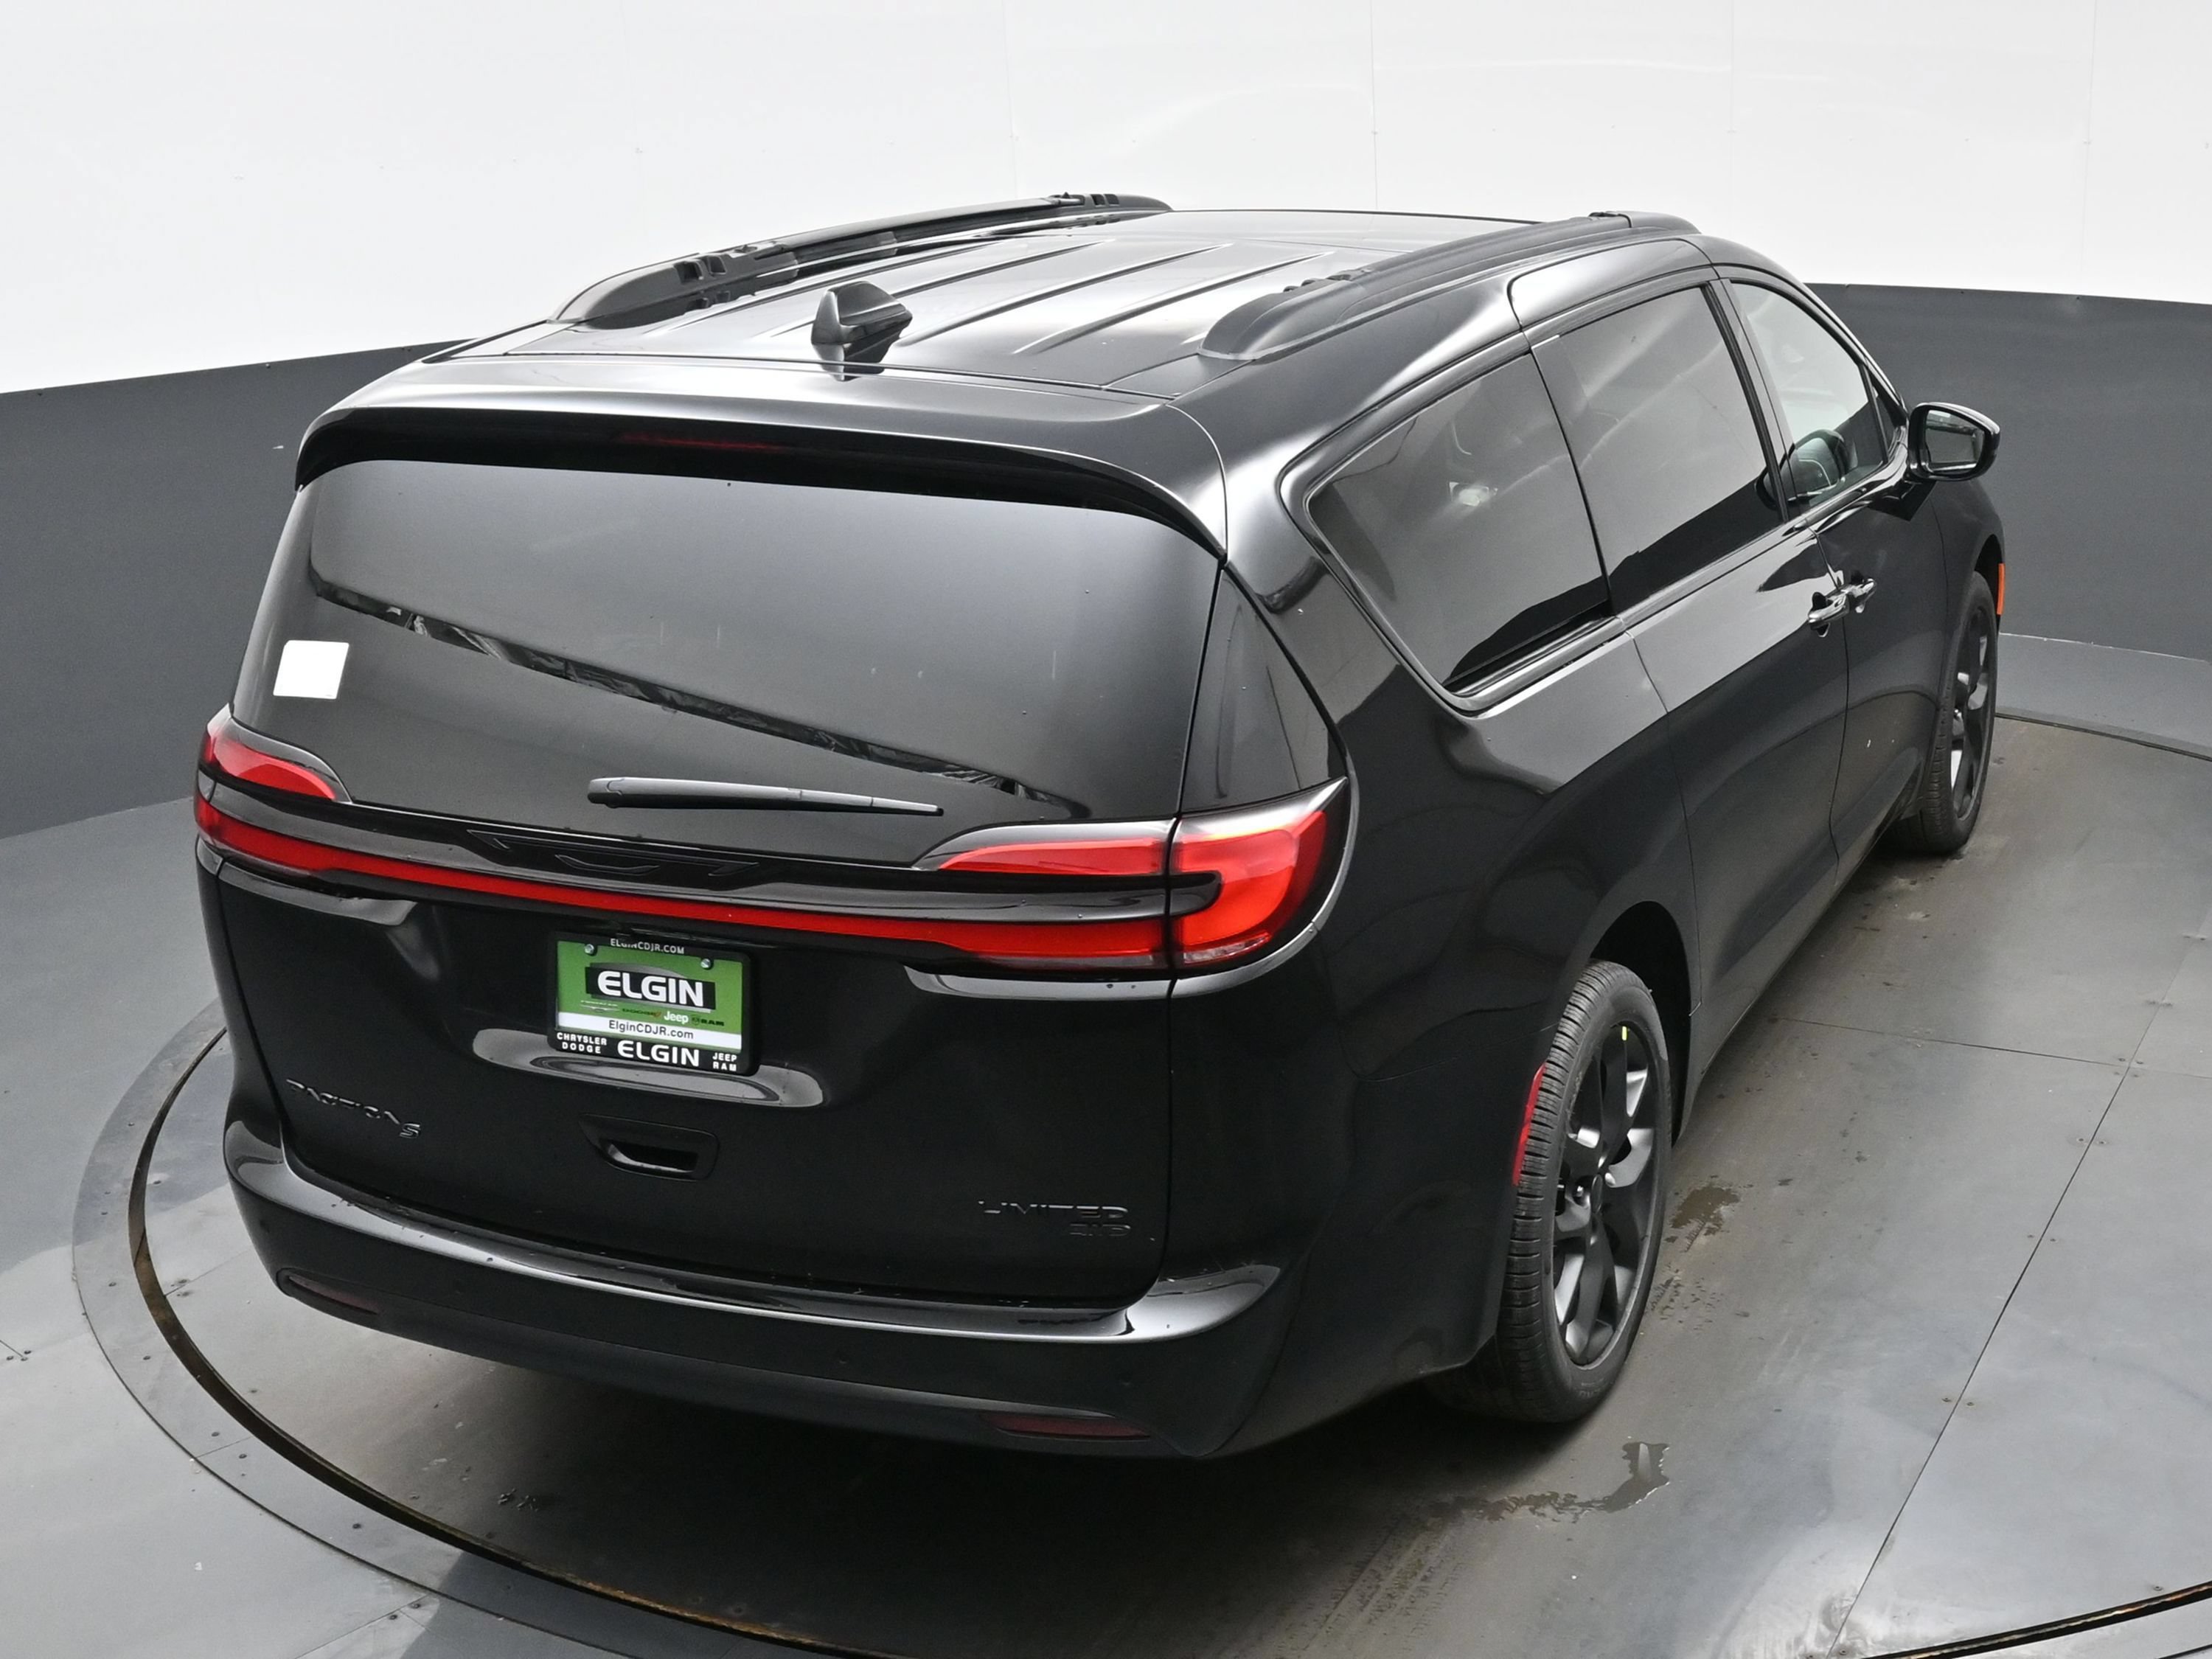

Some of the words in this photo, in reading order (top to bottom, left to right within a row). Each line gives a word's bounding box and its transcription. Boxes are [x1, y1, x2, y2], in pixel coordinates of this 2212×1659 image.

[597, 970, 703, 1007] ELGIN
[664, 1010, 689, 1024] Jeep
[608, 1020, 694, 1040] ElginCDJR.com
[557, 1032, 608, 1046] CHRYSLER
[562, 1043, 601, 1054] DODGE
[617, 1040, 700, 1067] ELGIN
[712, 1053, 737, 1062] JEEP
[713, 1062, 737, 1072] RAM
